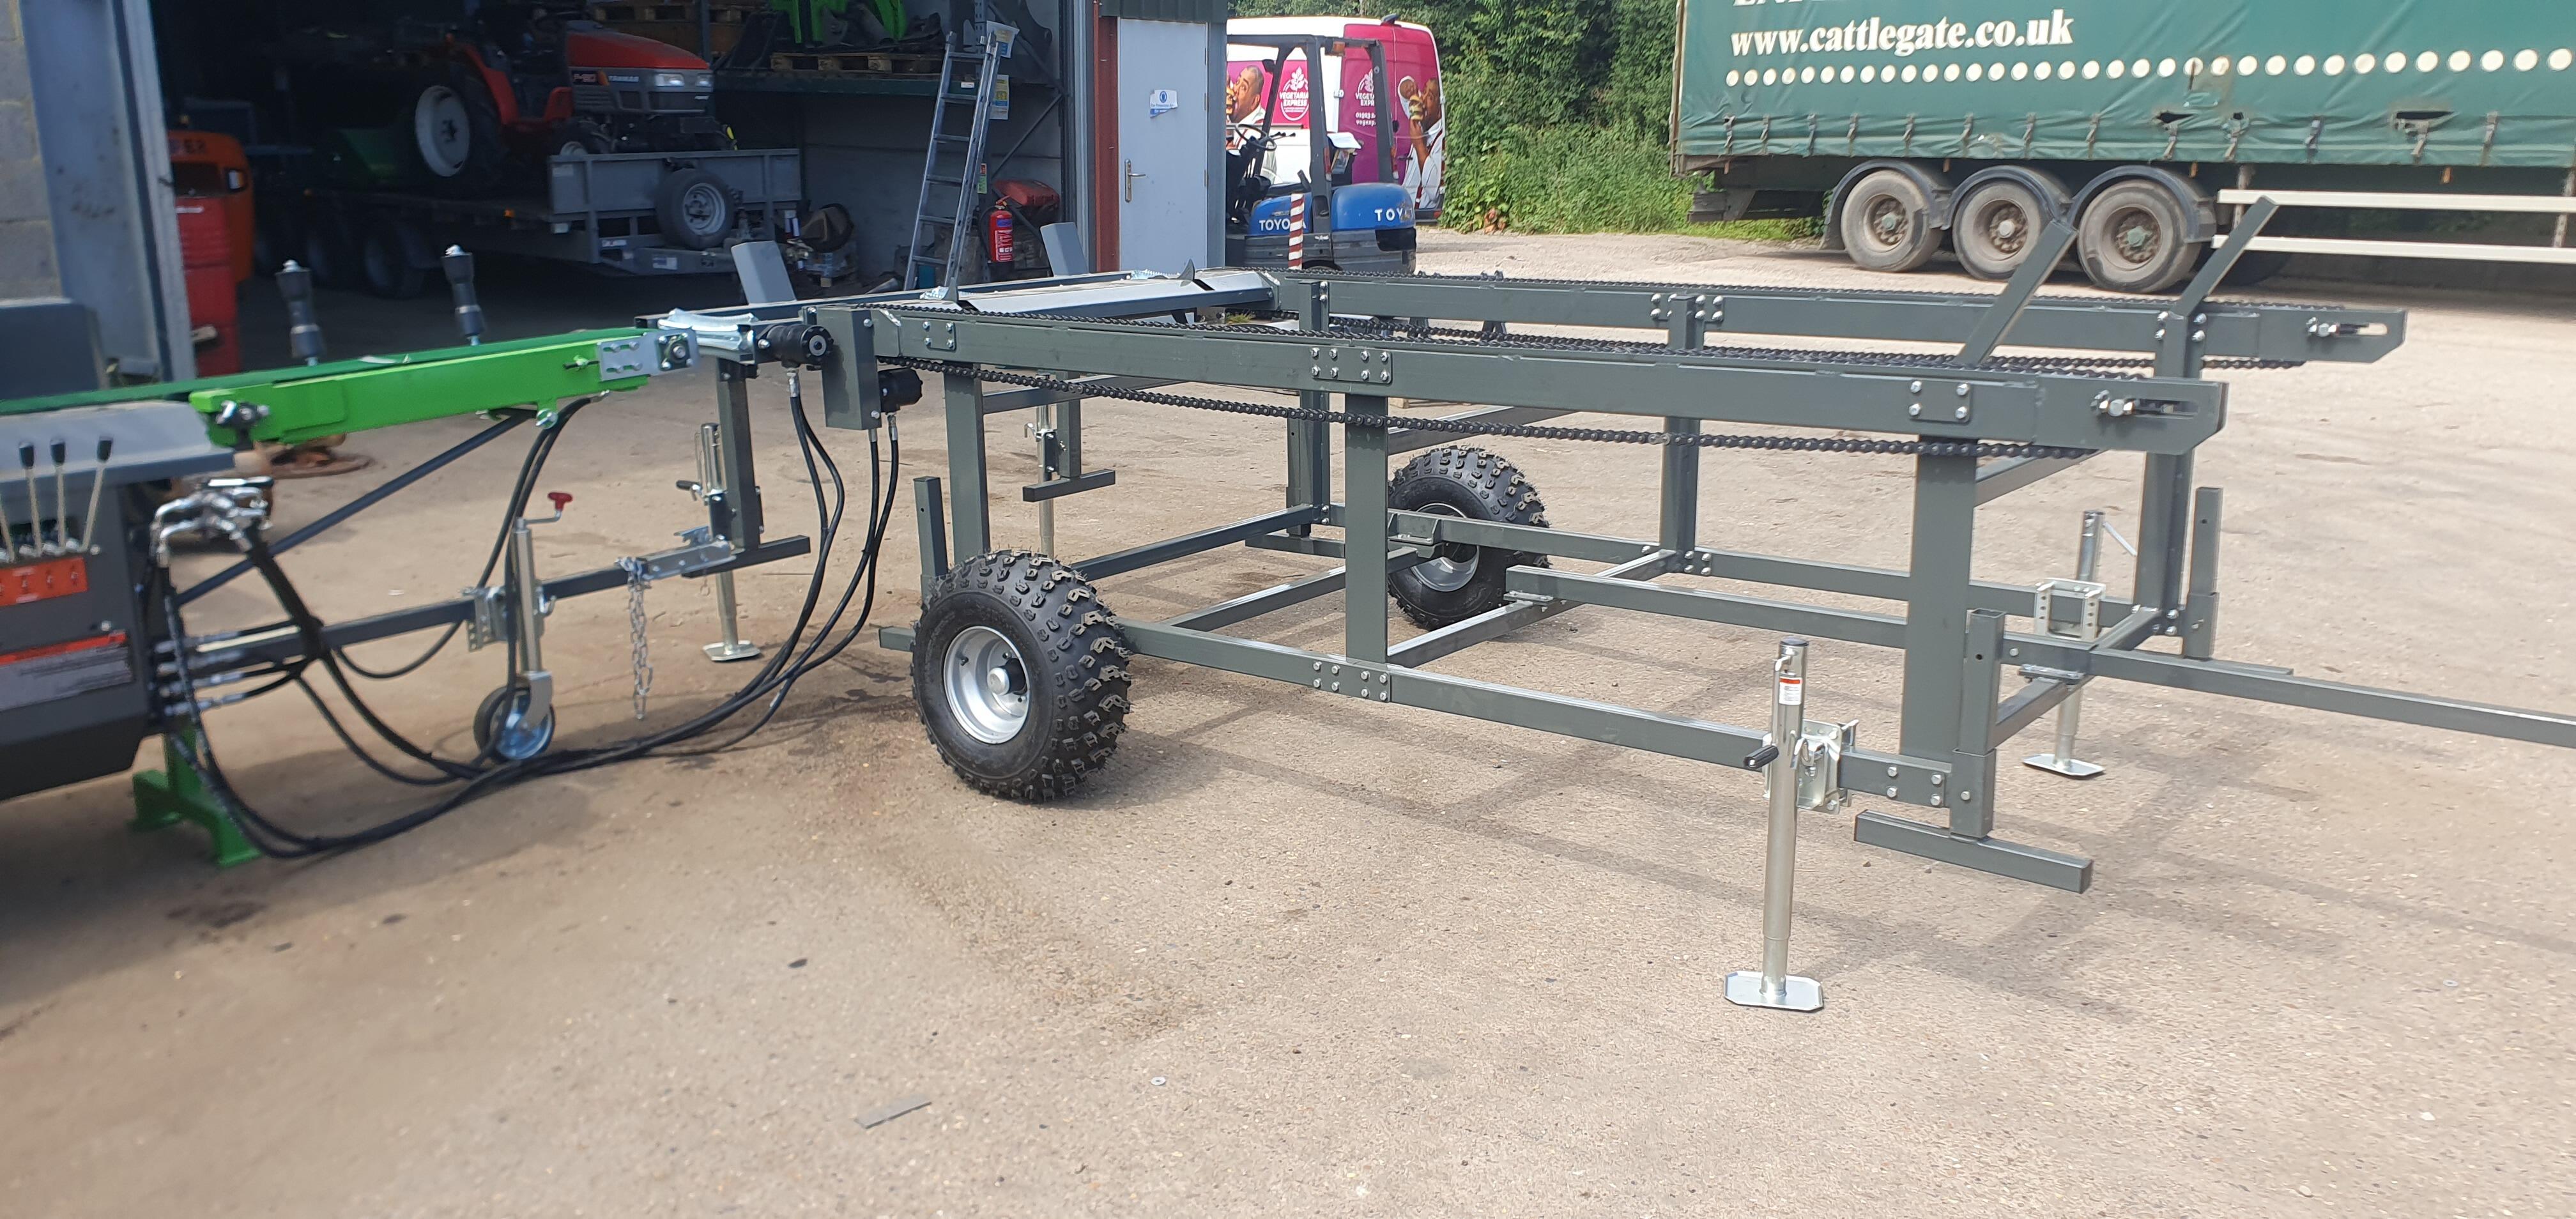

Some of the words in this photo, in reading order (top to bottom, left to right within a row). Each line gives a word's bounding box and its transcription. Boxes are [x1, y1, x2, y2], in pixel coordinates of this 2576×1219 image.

[1730, 9, 2074, 57] www.cattlegate.co.uk
[1279, 91, 1309, 100] VEGETARIA
[1374, 207, 1407, 222] TOY
[1259, 218, 1307, 231] TOYOA
